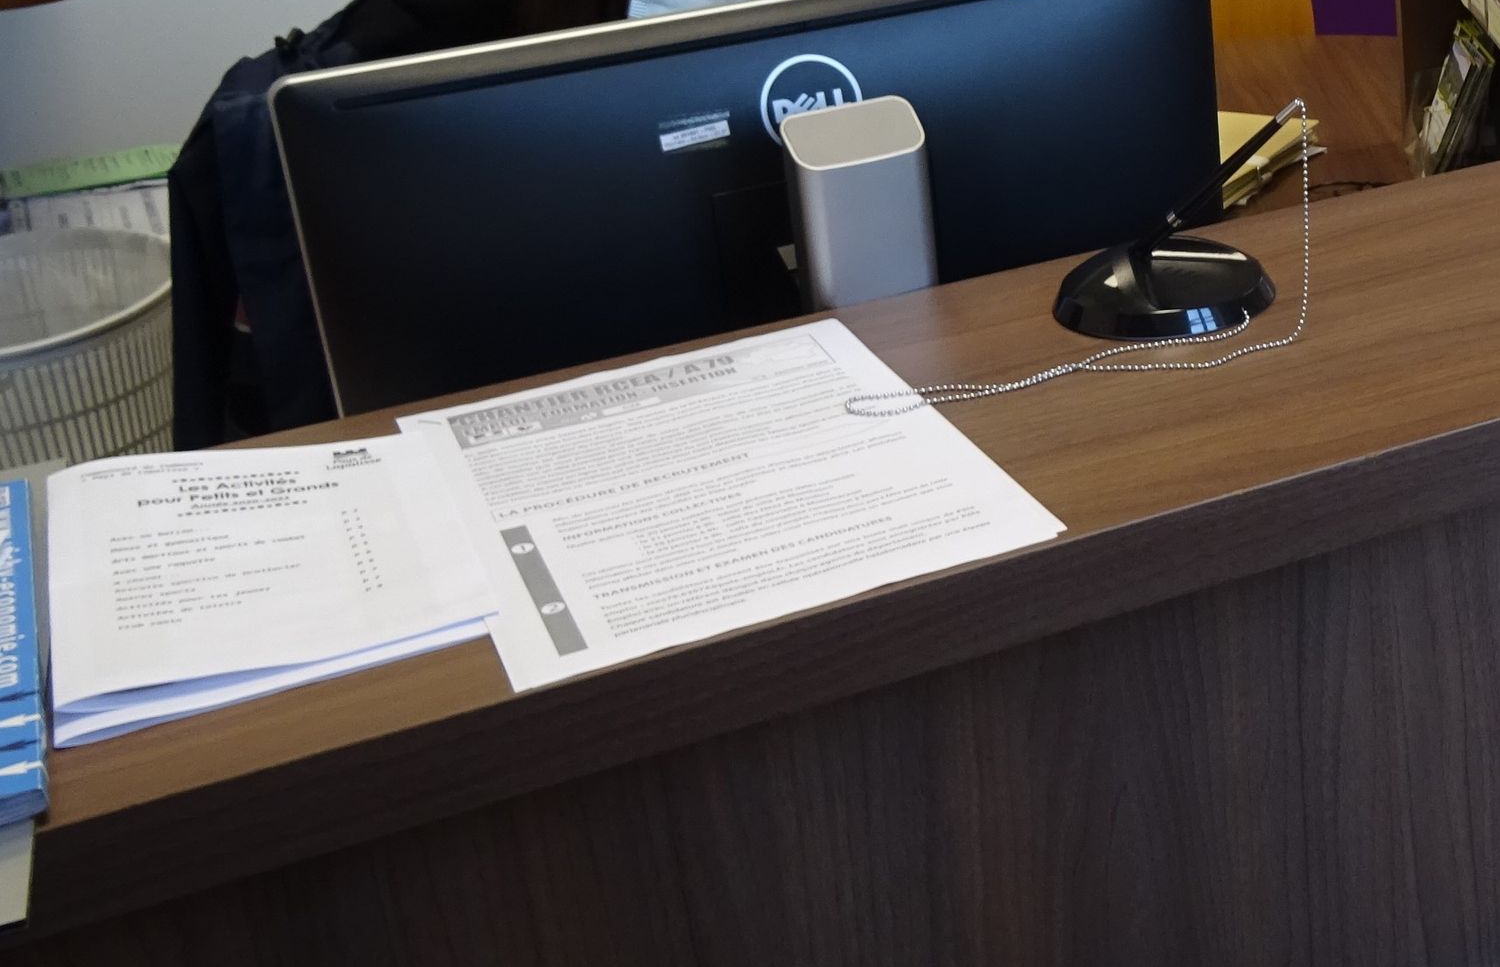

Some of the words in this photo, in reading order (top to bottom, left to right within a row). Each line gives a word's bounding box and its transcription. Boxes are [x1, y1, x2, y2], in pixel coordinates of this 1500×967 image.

[460, 389, 589, 425] CHANTIER
[137, 497, 182, 508] pour
[190, 492, 239, 502] Petits
[246, 489, 264, 497] et
[271, 482, 339, 495] Grands
[179, 484, 209, 493] Les
[216, 478, 297, 490] Activités
[499, 510, 519, 519] LA
[522, 488, 615, 513] PROCÉDURE
[619, 483, 638, 492] DE
[643, 452, 749, 485] RECRUTEMENT
